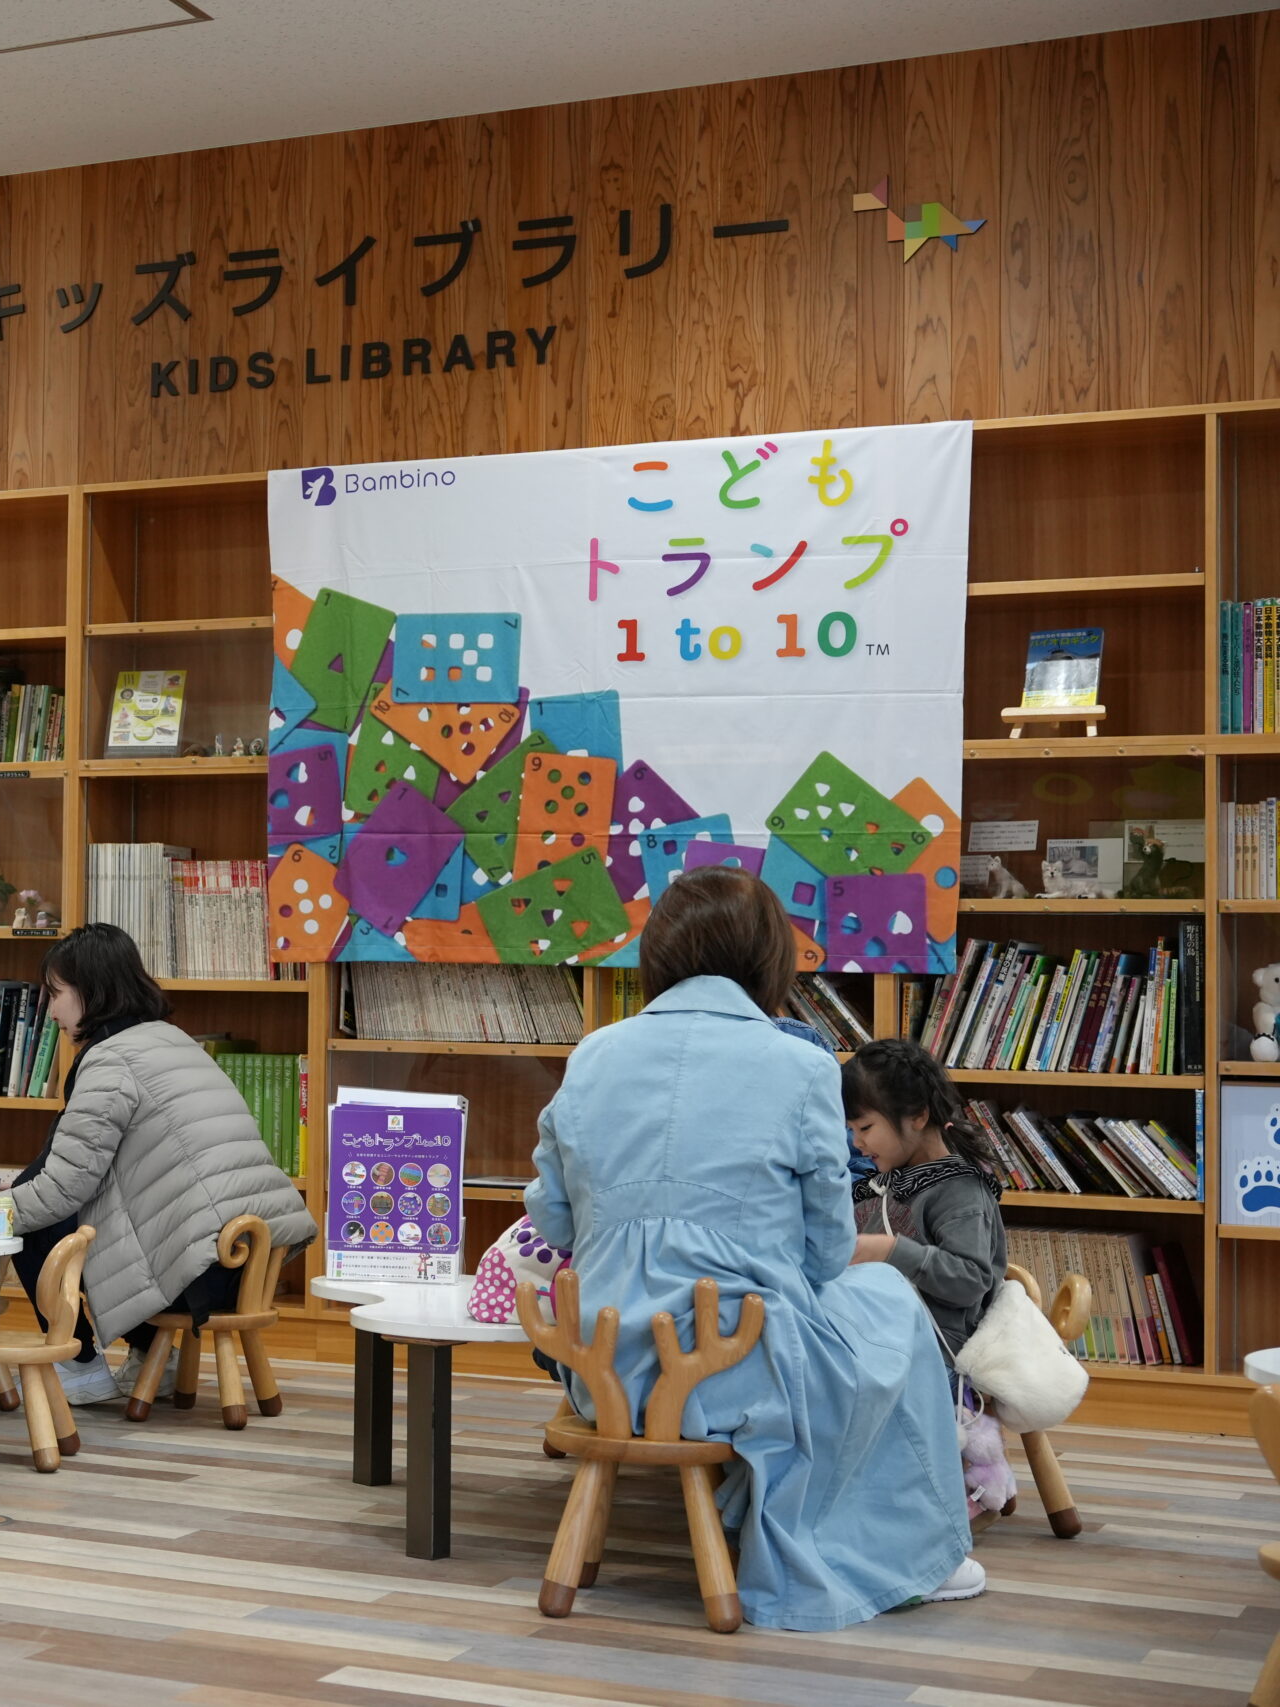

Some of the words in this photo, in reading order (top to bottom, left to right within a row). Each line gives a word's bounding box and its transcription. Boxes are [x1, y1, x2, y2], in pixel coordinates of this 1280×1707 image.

[150, 351, 276, 398] KIDS
[306, 325, 558, 385] LIBRARY
[344, 468, 456, 494] Bambino
[628, 439, 854, 512] こども
[589, 518, 909, 602] トランプ
[617, 619, 645, 662] 1
[676, 618, 742, 661] to
[776, 611, 857, 659] 10
[866, 643, 890, 656] TM
[373, 700, 391, 715] 10
[531, 757, 543, 771] 9
[646, 834, 657, 849] 8
[832, 880, 845, 897] 5
